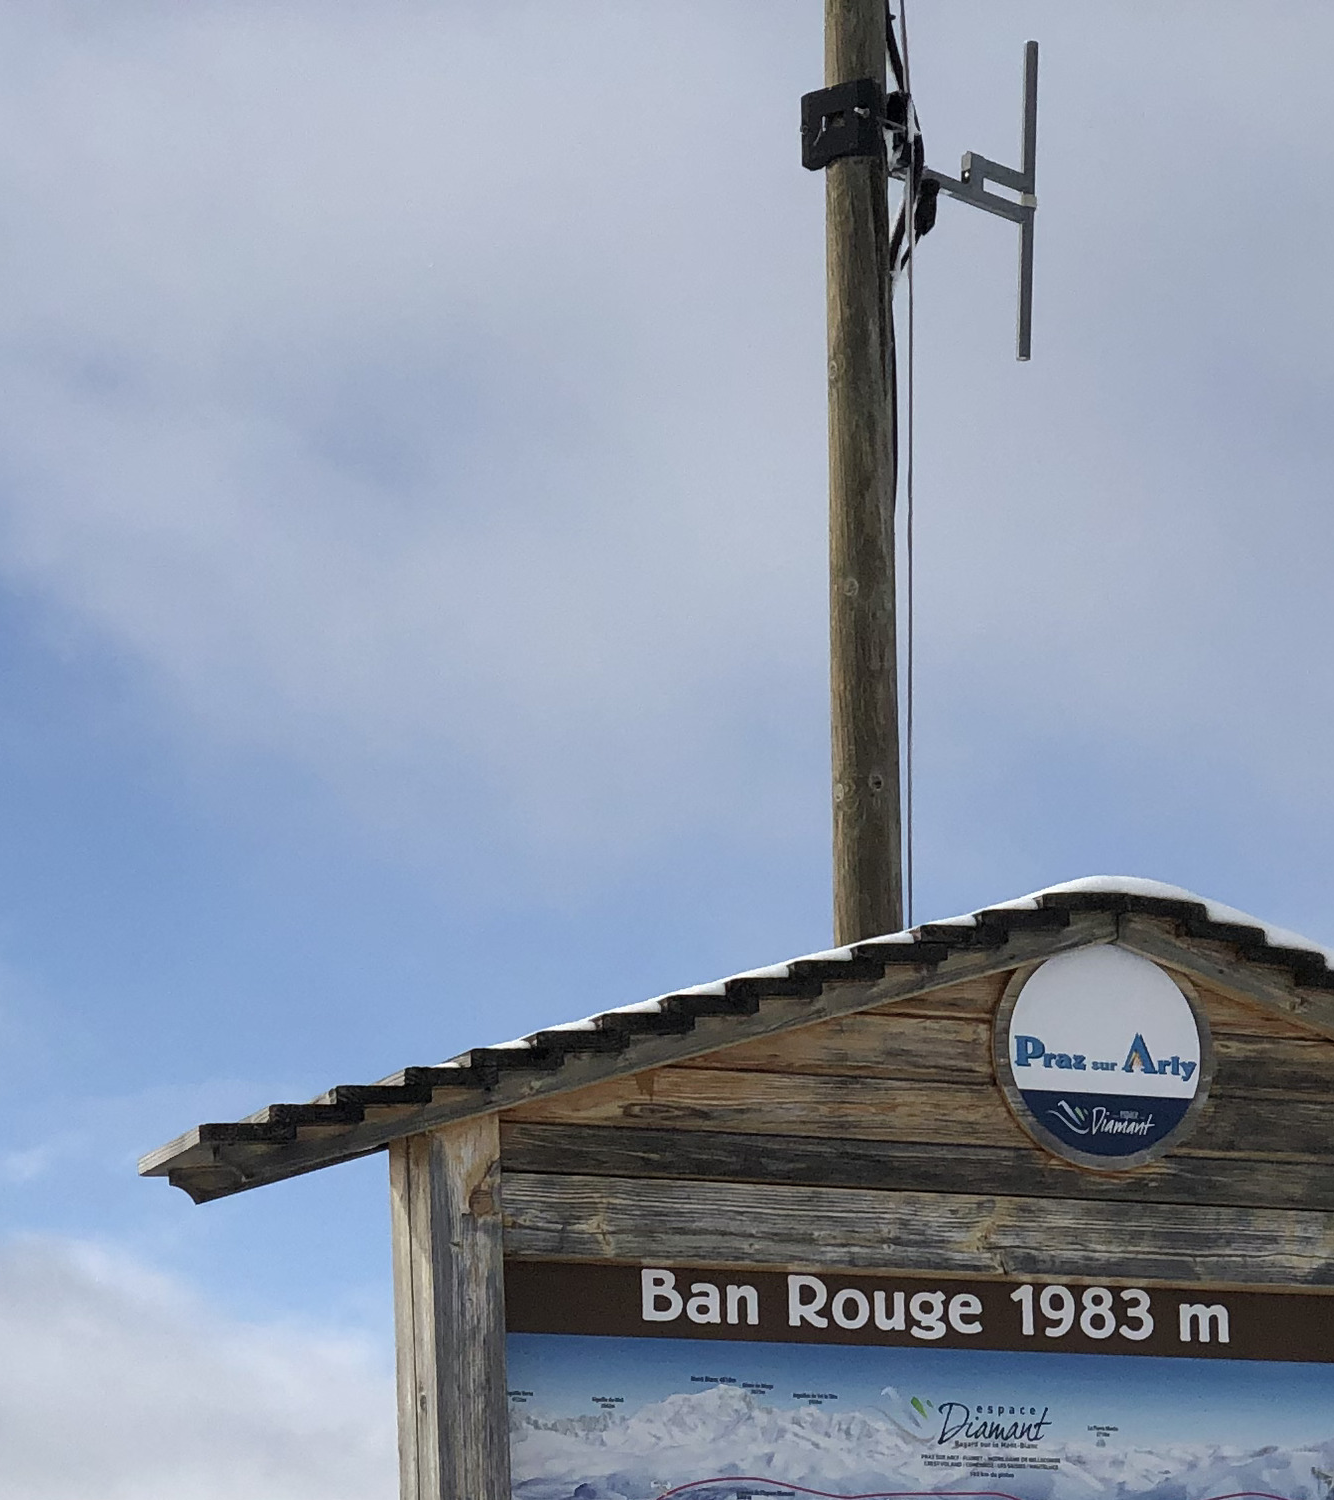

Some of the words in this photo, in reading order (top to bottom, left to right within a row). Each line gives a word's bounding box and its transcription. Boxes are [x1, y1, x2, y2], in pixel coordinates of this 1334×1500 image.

[1014, 1035, 1086, 1070] Praz
[1091, 1060, 1117, 1071] sur
[1122, 1032, 1198, 1081] Arly
[1092, 1106, 1155, 1135] Diamant
[640, 1268, 759, 1325] Ban
[787, 1274, 984, 1339] Rouge
[1010, 1284, 1154, 1341] 1983
[1179, 1302, 1230, 1344] m
[937, 1402, 1052, 1445] Diamant
[976, 1405, 1037, 1417] espace
